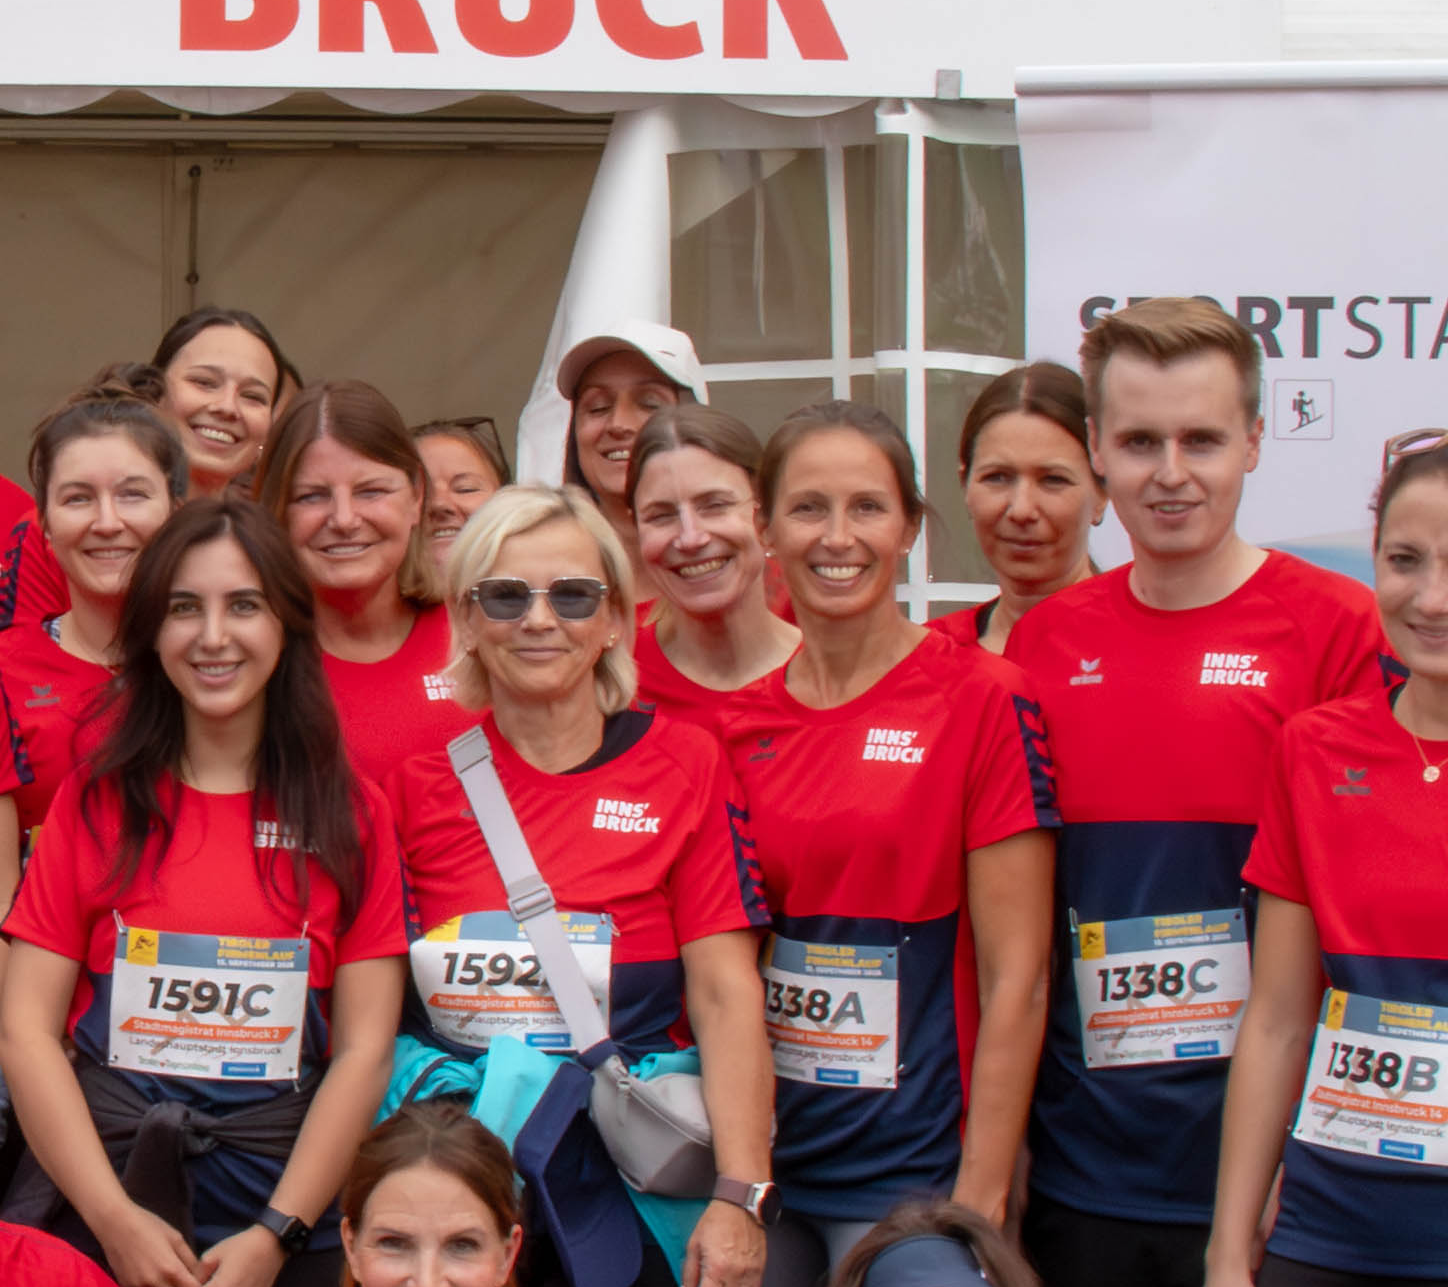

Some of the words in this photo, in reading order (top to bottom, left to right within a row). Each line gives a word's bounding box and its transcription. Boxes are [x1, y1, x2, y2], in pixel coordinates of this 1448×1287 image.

[1200, 667, 1269, 688] BRUCK
[862, 742, 925, 764] BRUCK
[592, 814, 660, 834] BRUCK
[443, 952, 550, 991] 1592
[1096, 958, 1220, 1002] 1338C
[148, 976, 275, 1017] 1591C
[437, 996, 515, 1009] Stadtmagistrat
[1161, 1006, 1214, 1020] Innsbruck
[133, 1019, 214, 1037] Stadtmagistrat
[216, 1028, 270, 1038] Innsbruck
[1326, 1041, 1440, 1093] 1338B
[1372, 1100, 1427, 1117] Innsbruck
